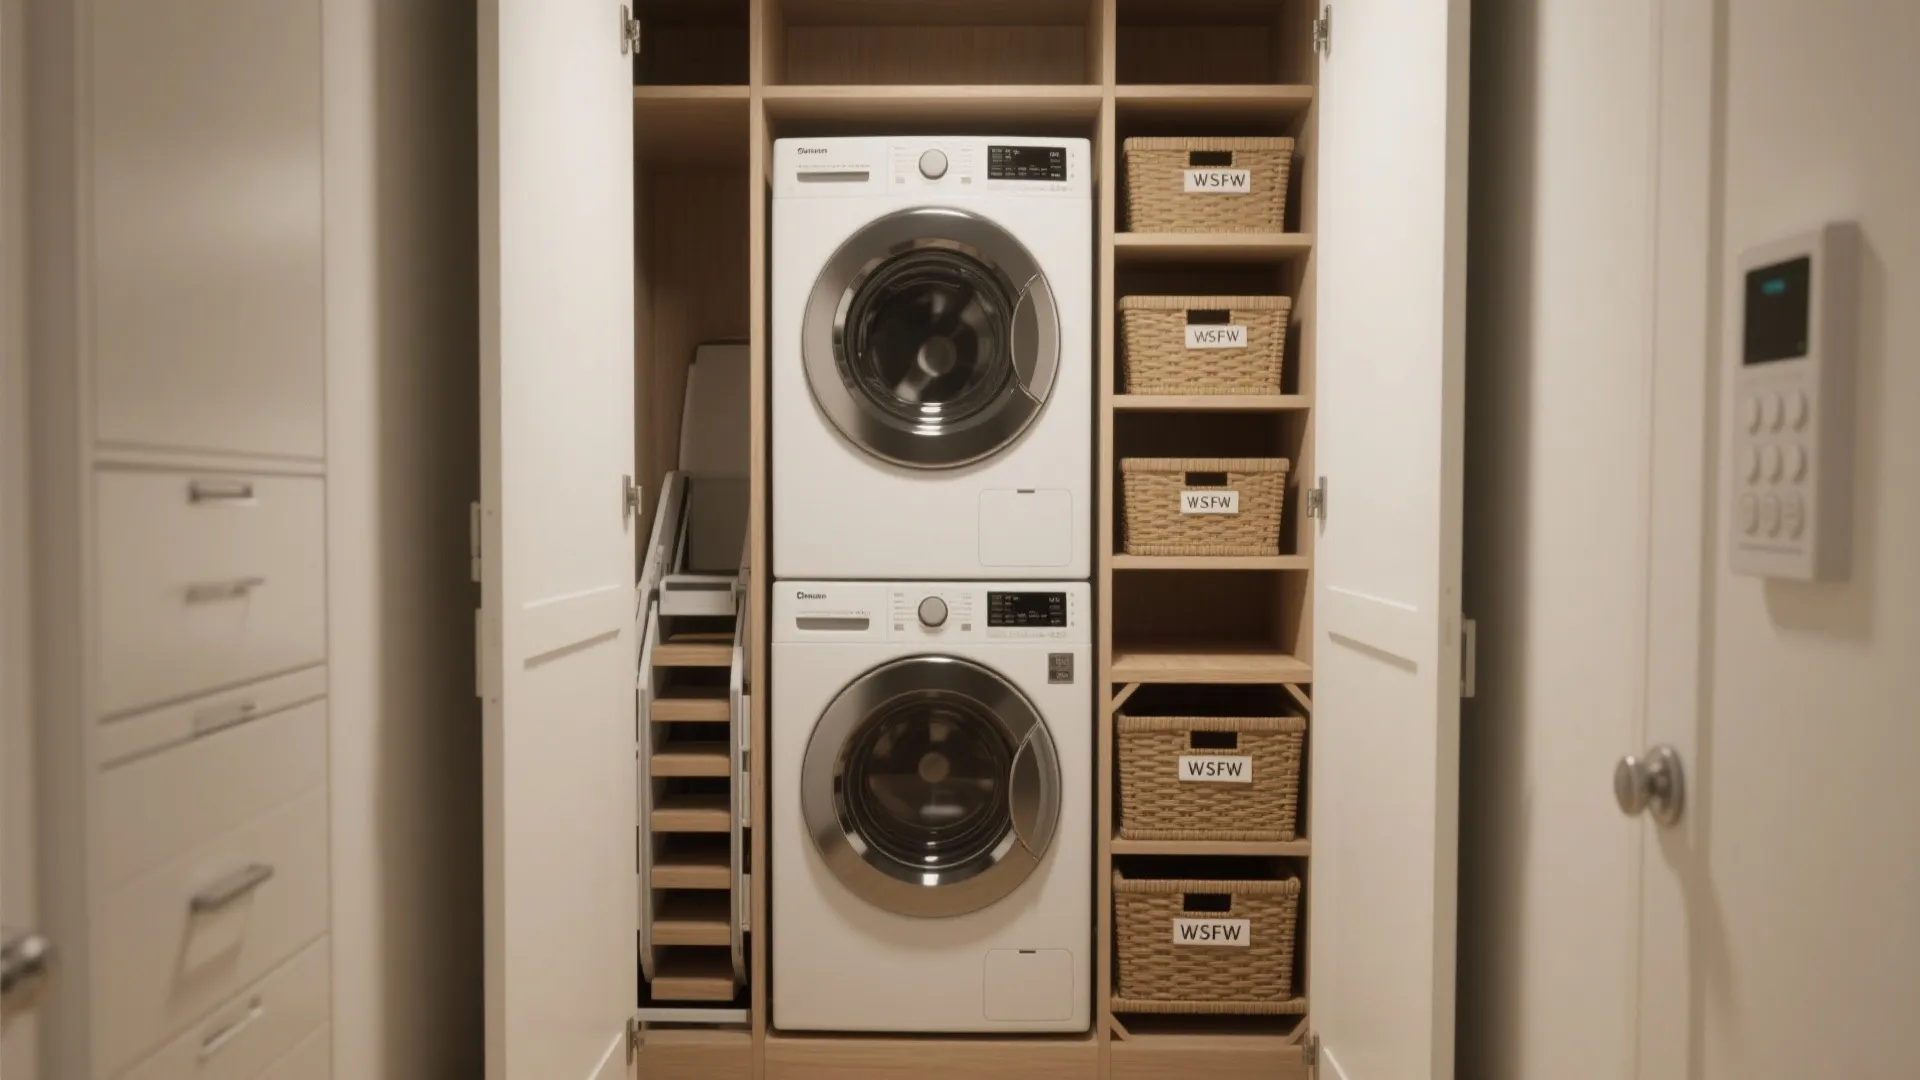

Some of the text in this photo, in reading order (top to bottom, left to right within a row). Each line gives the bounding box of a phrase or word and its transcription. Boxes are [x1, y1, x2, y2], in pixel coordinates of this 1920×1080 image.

[1193, 173, 1246, 187] WSFW
[1194, 330, 1239, 343] WSFW
[1186, 496, 1231, 509] WSFW
[1188, 761, 1243, 777] WSFW
[1180, 924, 1242, 941] WSFW
